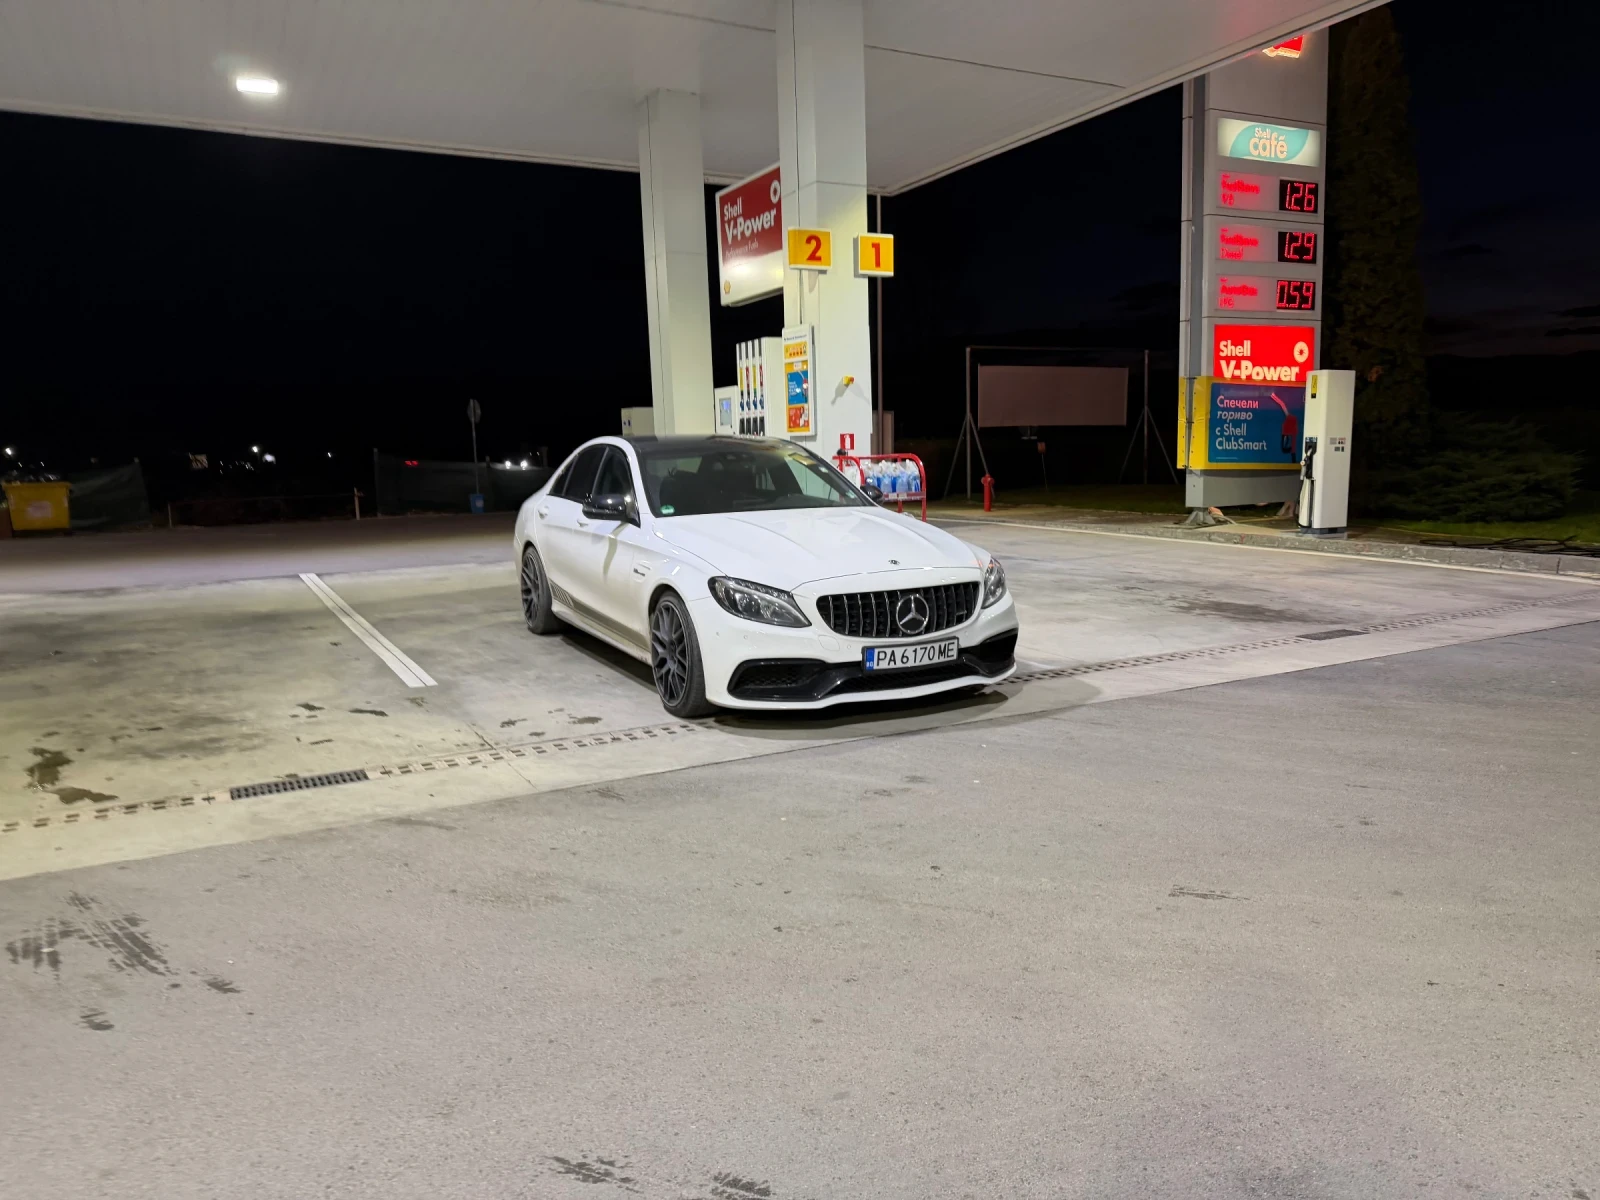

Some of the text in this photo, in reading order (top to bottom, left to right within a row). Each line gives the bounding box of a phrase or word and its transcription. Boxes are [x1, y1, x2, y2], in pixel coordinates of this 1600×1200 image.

[1255, 127, 1271, 138] Shell
[1249, 132, 1288, 159] café
[723, 196, 742, 222] Shell
[724, 207, 776, 246] V-Power
[805, 234, 822, 262] 2
[871, 242, 881, 268] 1
[1219, 340, 1252, 357] Shell
[1219, 359, 1300, 382] V-Power
[1216, 395, 1259, 409] Спечели
[1216, 411, 1253, 423] гориво
[1223, 422, 1247, 436] Shell
[1215, 436, 1267, 450] ClubSmart
